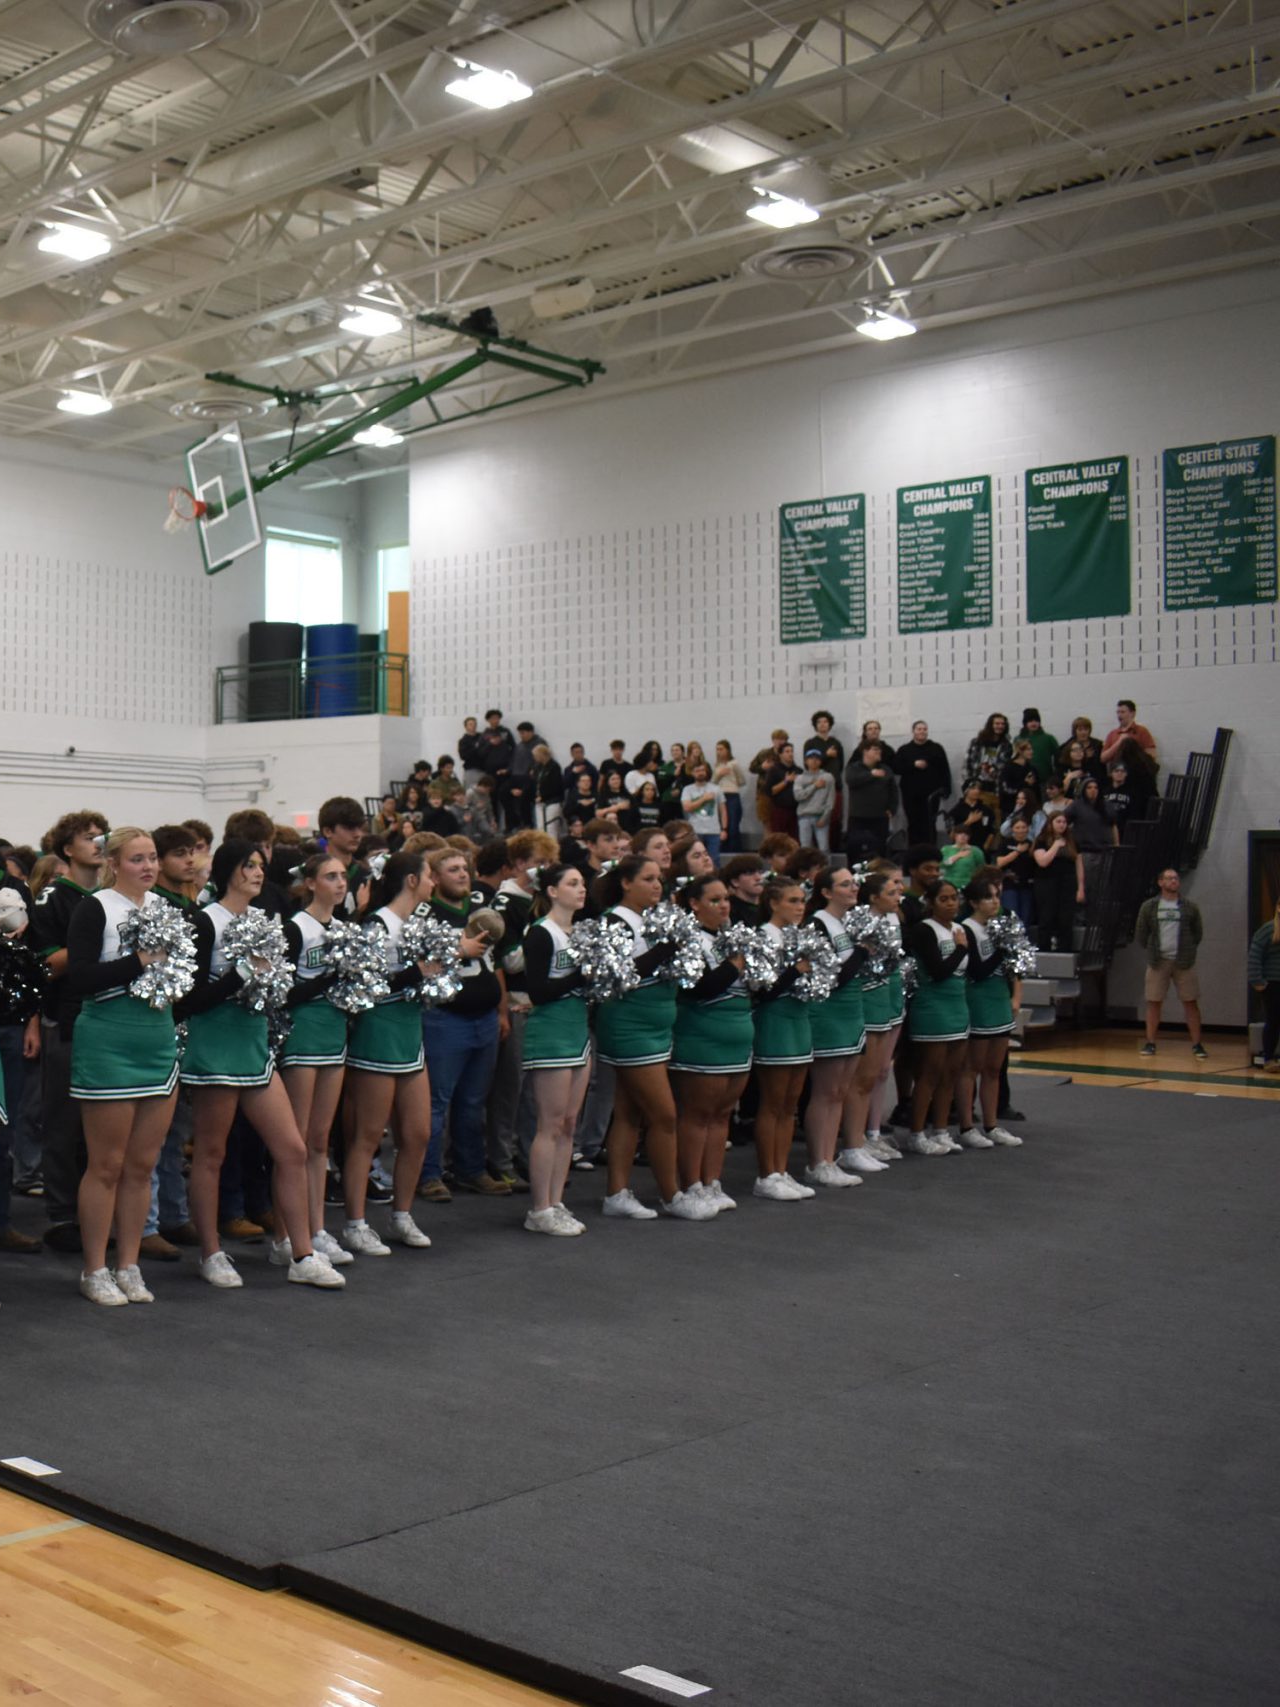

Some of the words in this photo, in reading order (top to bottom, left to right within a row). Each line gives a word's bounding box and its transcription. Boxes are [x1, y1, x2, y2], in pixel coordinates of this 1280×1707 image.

[1178, 450, 1222, 465] CENTER
[1226, 443, 1260, 459] STATE
[1032, 468, 1079, 486] CENTRAL
[1082, 462, 1120, 479] VALLEY
[1183, 461, 1255, 481] CHAMPIONS
[903, 487, 946, 503] CENTRAL
[949, 481, 984, 496] VALLEY
[1043, 480, 1109, 499] CHAMPIONS
[785, 504, 824, 519] CENTRAL
[826, 498, 858, 514] VALLEY
[914, 498, 974, 516] CHAMPIONS
[794, 515, 849, 532] CHAMPIONS
